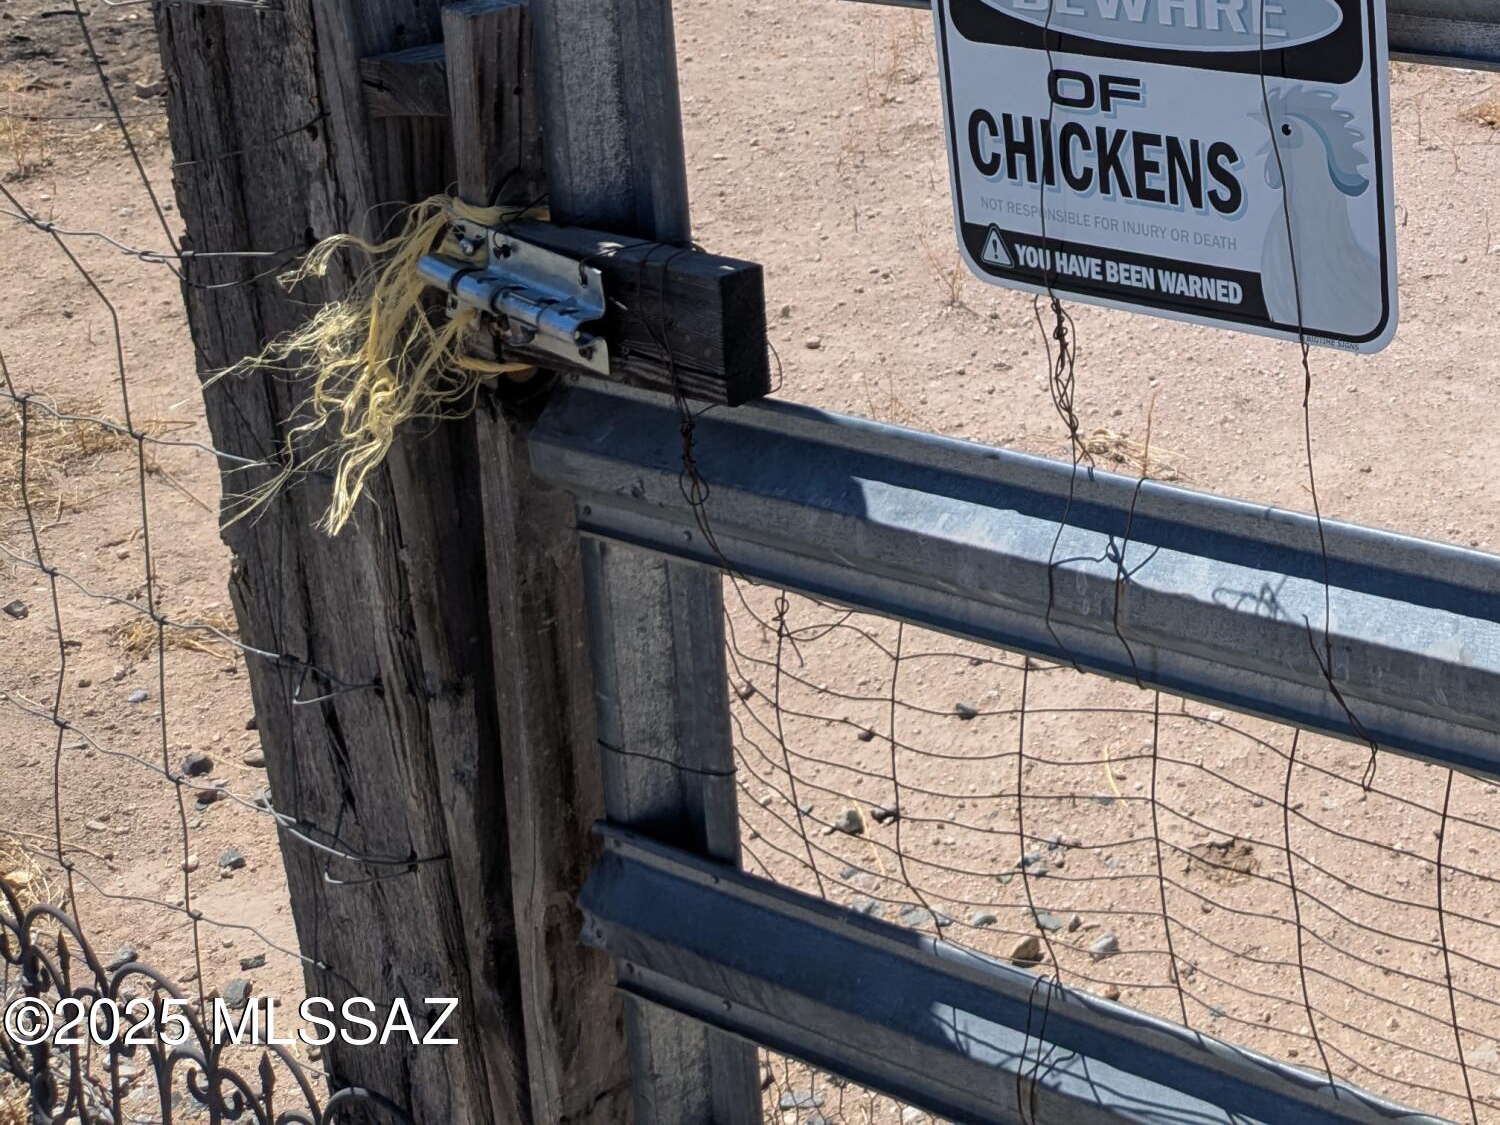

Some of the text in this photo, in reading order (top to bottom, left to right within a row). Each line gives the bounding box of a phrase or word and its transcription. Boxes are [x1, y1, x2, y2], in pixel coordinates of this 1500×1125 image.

[1048, 69, 1142, 112] OF
[968, 108, 1243, 214] CHICKENS
[980, 196, 1004, 212] NOT
[1094, 216, 1119, 233] FOR
[1123, 221, 1167, 241] INJURY
[1170, 228, 1190, 244] OR
[1193, 232, 1238, 251] DEATH
[1014, 243, 1243, 305] YOU HAVE BEEN WARNED
